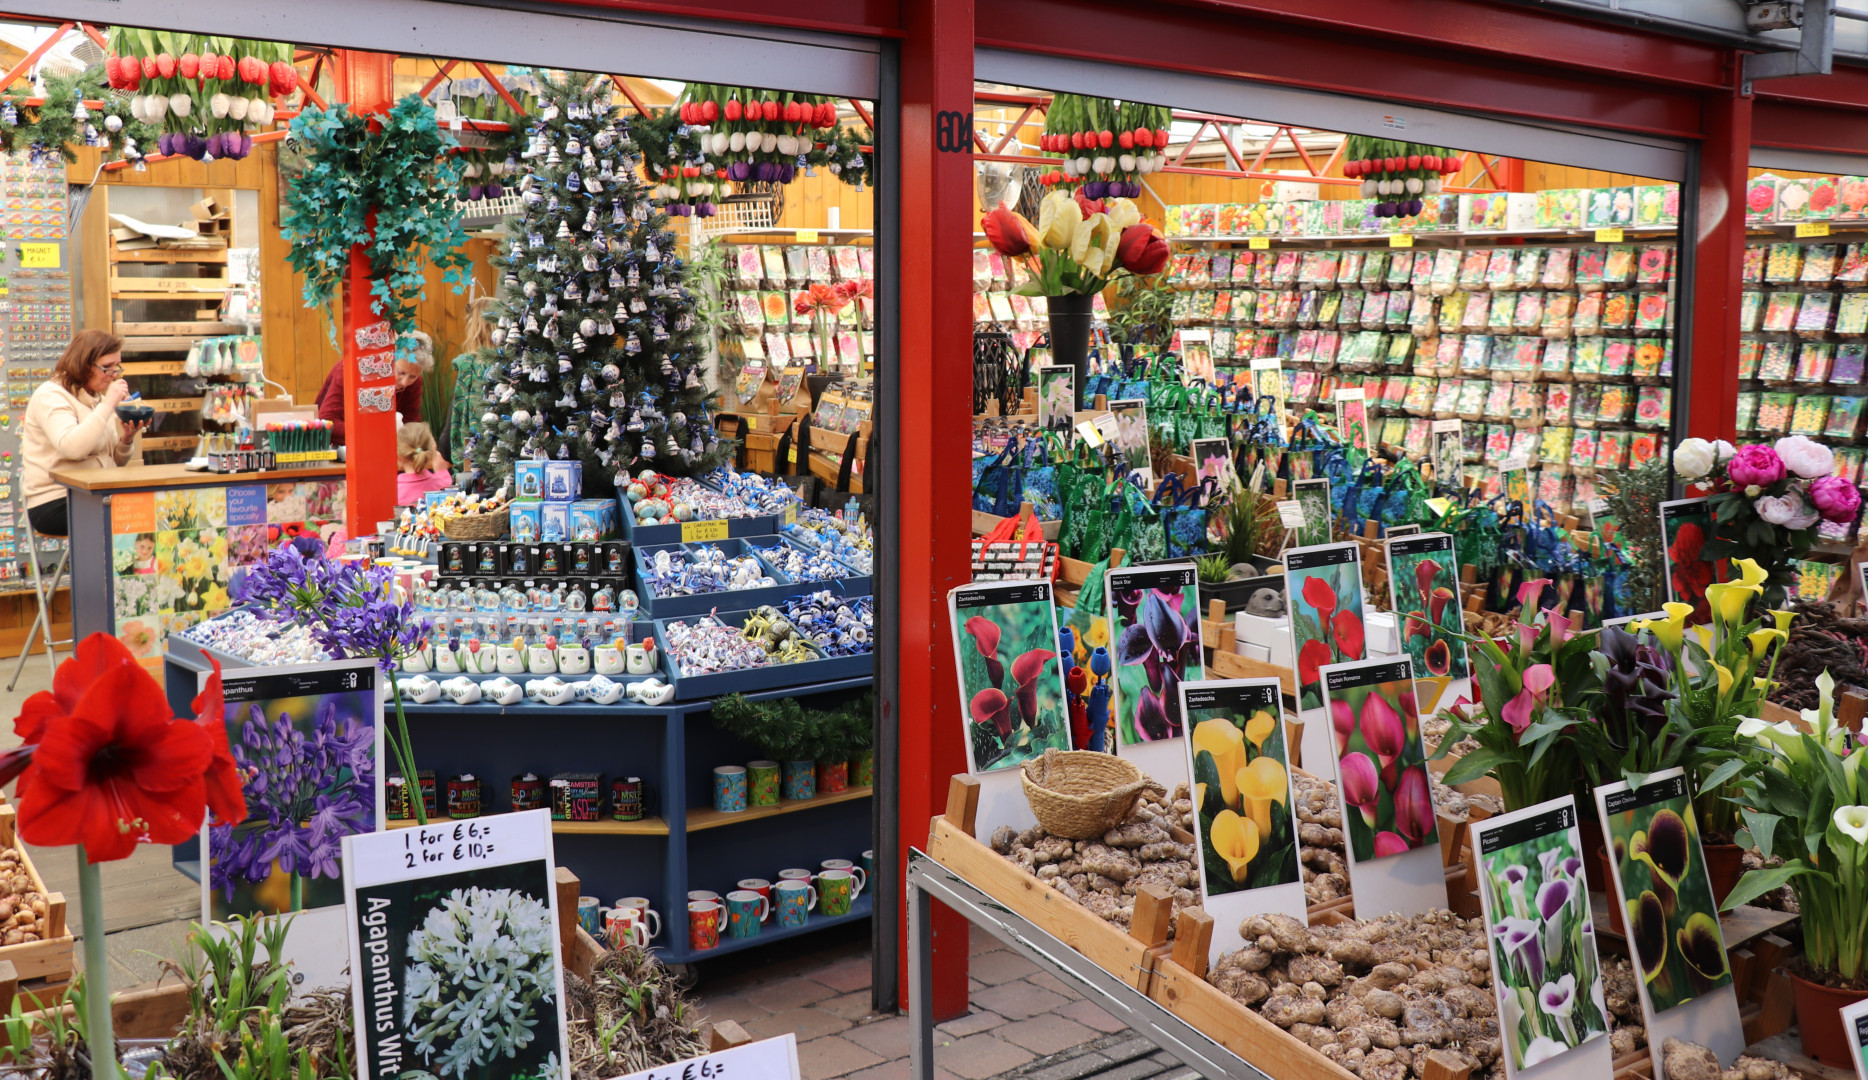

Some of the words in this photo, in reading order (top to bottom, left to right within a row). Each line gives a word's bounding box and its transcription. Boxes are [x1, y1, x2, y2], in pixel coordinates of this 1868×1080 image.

[937, 111, 973, 154] 604
[228, 488, 256, 497] Choose
[228, 498, 244, 506] your
[229, 504, 257, 513] favourite
[230, 512, 260, 522] specialty
[223, 686, 253, 696] apanthus
[1188, 695, 1215, 703] Zantedeschia
[1607, 799, 1621, 807] Captain
[405, 833, 409, 849] 1
[420, 830, 444, 845] for
[1482, 836, 1499, 846] Picasso
[405, 853, 416, 868] 2
[423, 849, 444, 862] for
[362, 897, 398, 1033] Agapanthus
[377, 1033, 403, 1077] Wit
